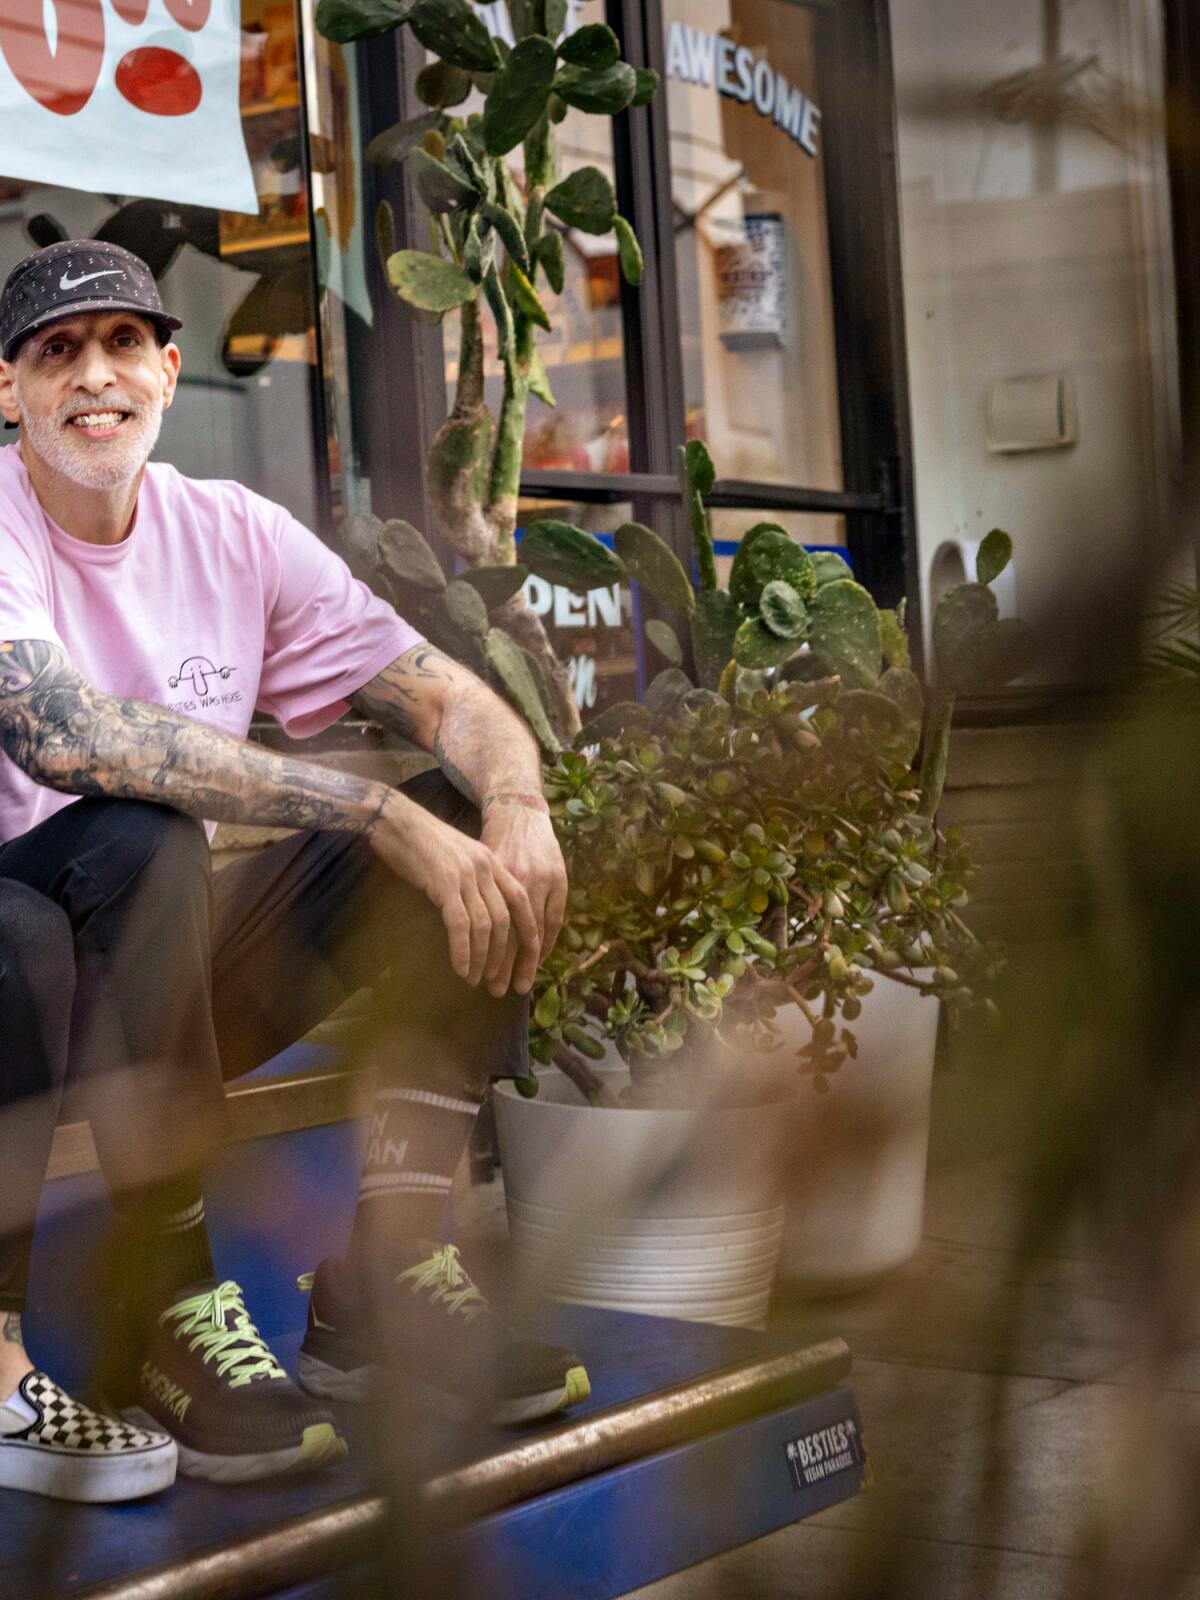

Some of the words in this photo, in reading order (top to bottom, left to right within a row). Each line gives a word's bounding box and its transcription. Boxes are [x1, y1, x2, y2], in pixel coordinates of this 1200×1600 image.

[666, 21, 821, 157] AWESOME
[520, 573, 623, 628] PEN
[797, 1423, 849, 1468] BESTIES
[803, 1463, 825, 1484] VEGAN
[823, 1450, 853, 1476] PARADISE
